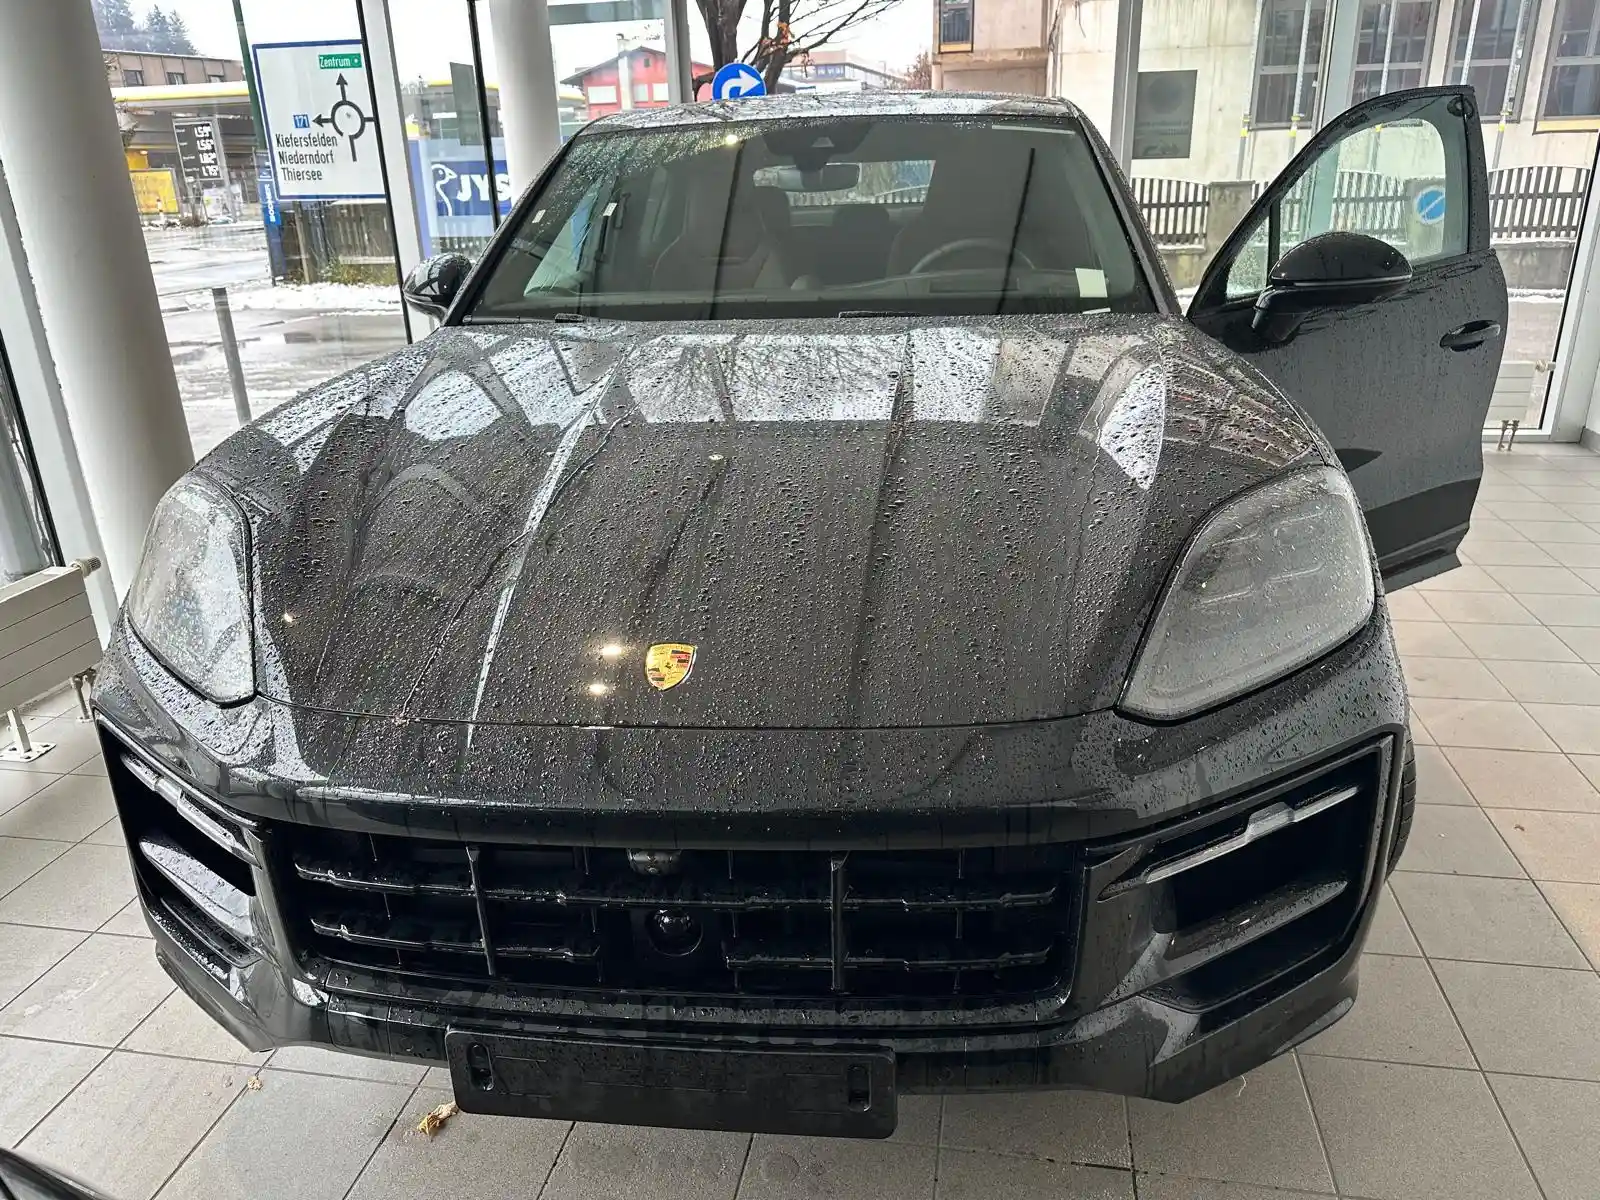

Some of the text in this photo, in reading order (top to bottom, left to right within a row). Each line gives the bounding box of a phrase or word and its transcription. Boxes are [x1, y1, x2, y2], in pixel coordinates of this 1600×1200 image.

[319, 56, 351, 68] Zentrum
[295, 115, 309, 128] 171
[275, 132, 338, 148] Kiefersfelden
[278, 149, 335, 165] Niederndorf
[281, 166, 323, 181] Thiersee
[456, 173, 511, 201] JYS
